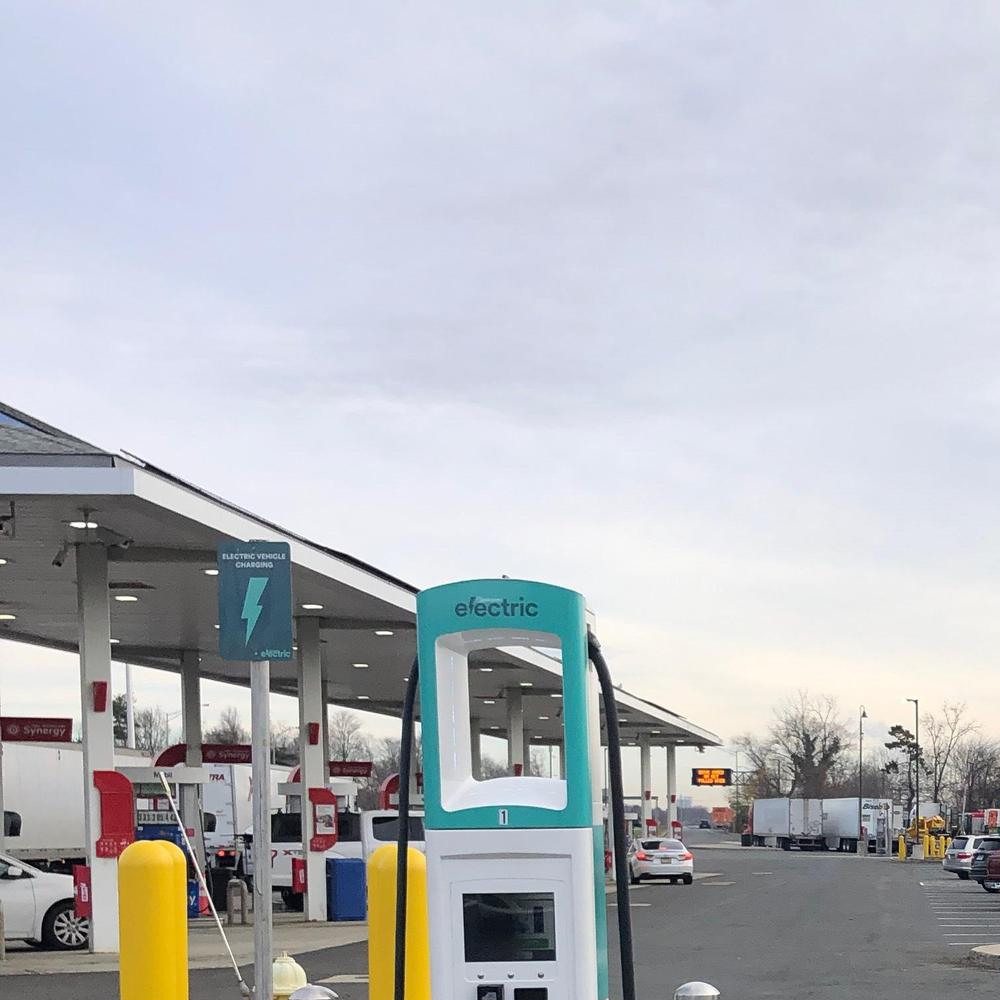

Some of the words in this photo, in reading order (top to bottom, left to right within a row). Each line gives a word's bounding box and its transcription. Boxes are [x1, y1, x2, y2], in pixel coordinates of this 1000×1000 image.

[235, 561, 274, 569] CHARGING
[454, 596, 538, 617] electric
[23, 725, 66, 737] Synergy
[501, 811, 506, 824] 1
